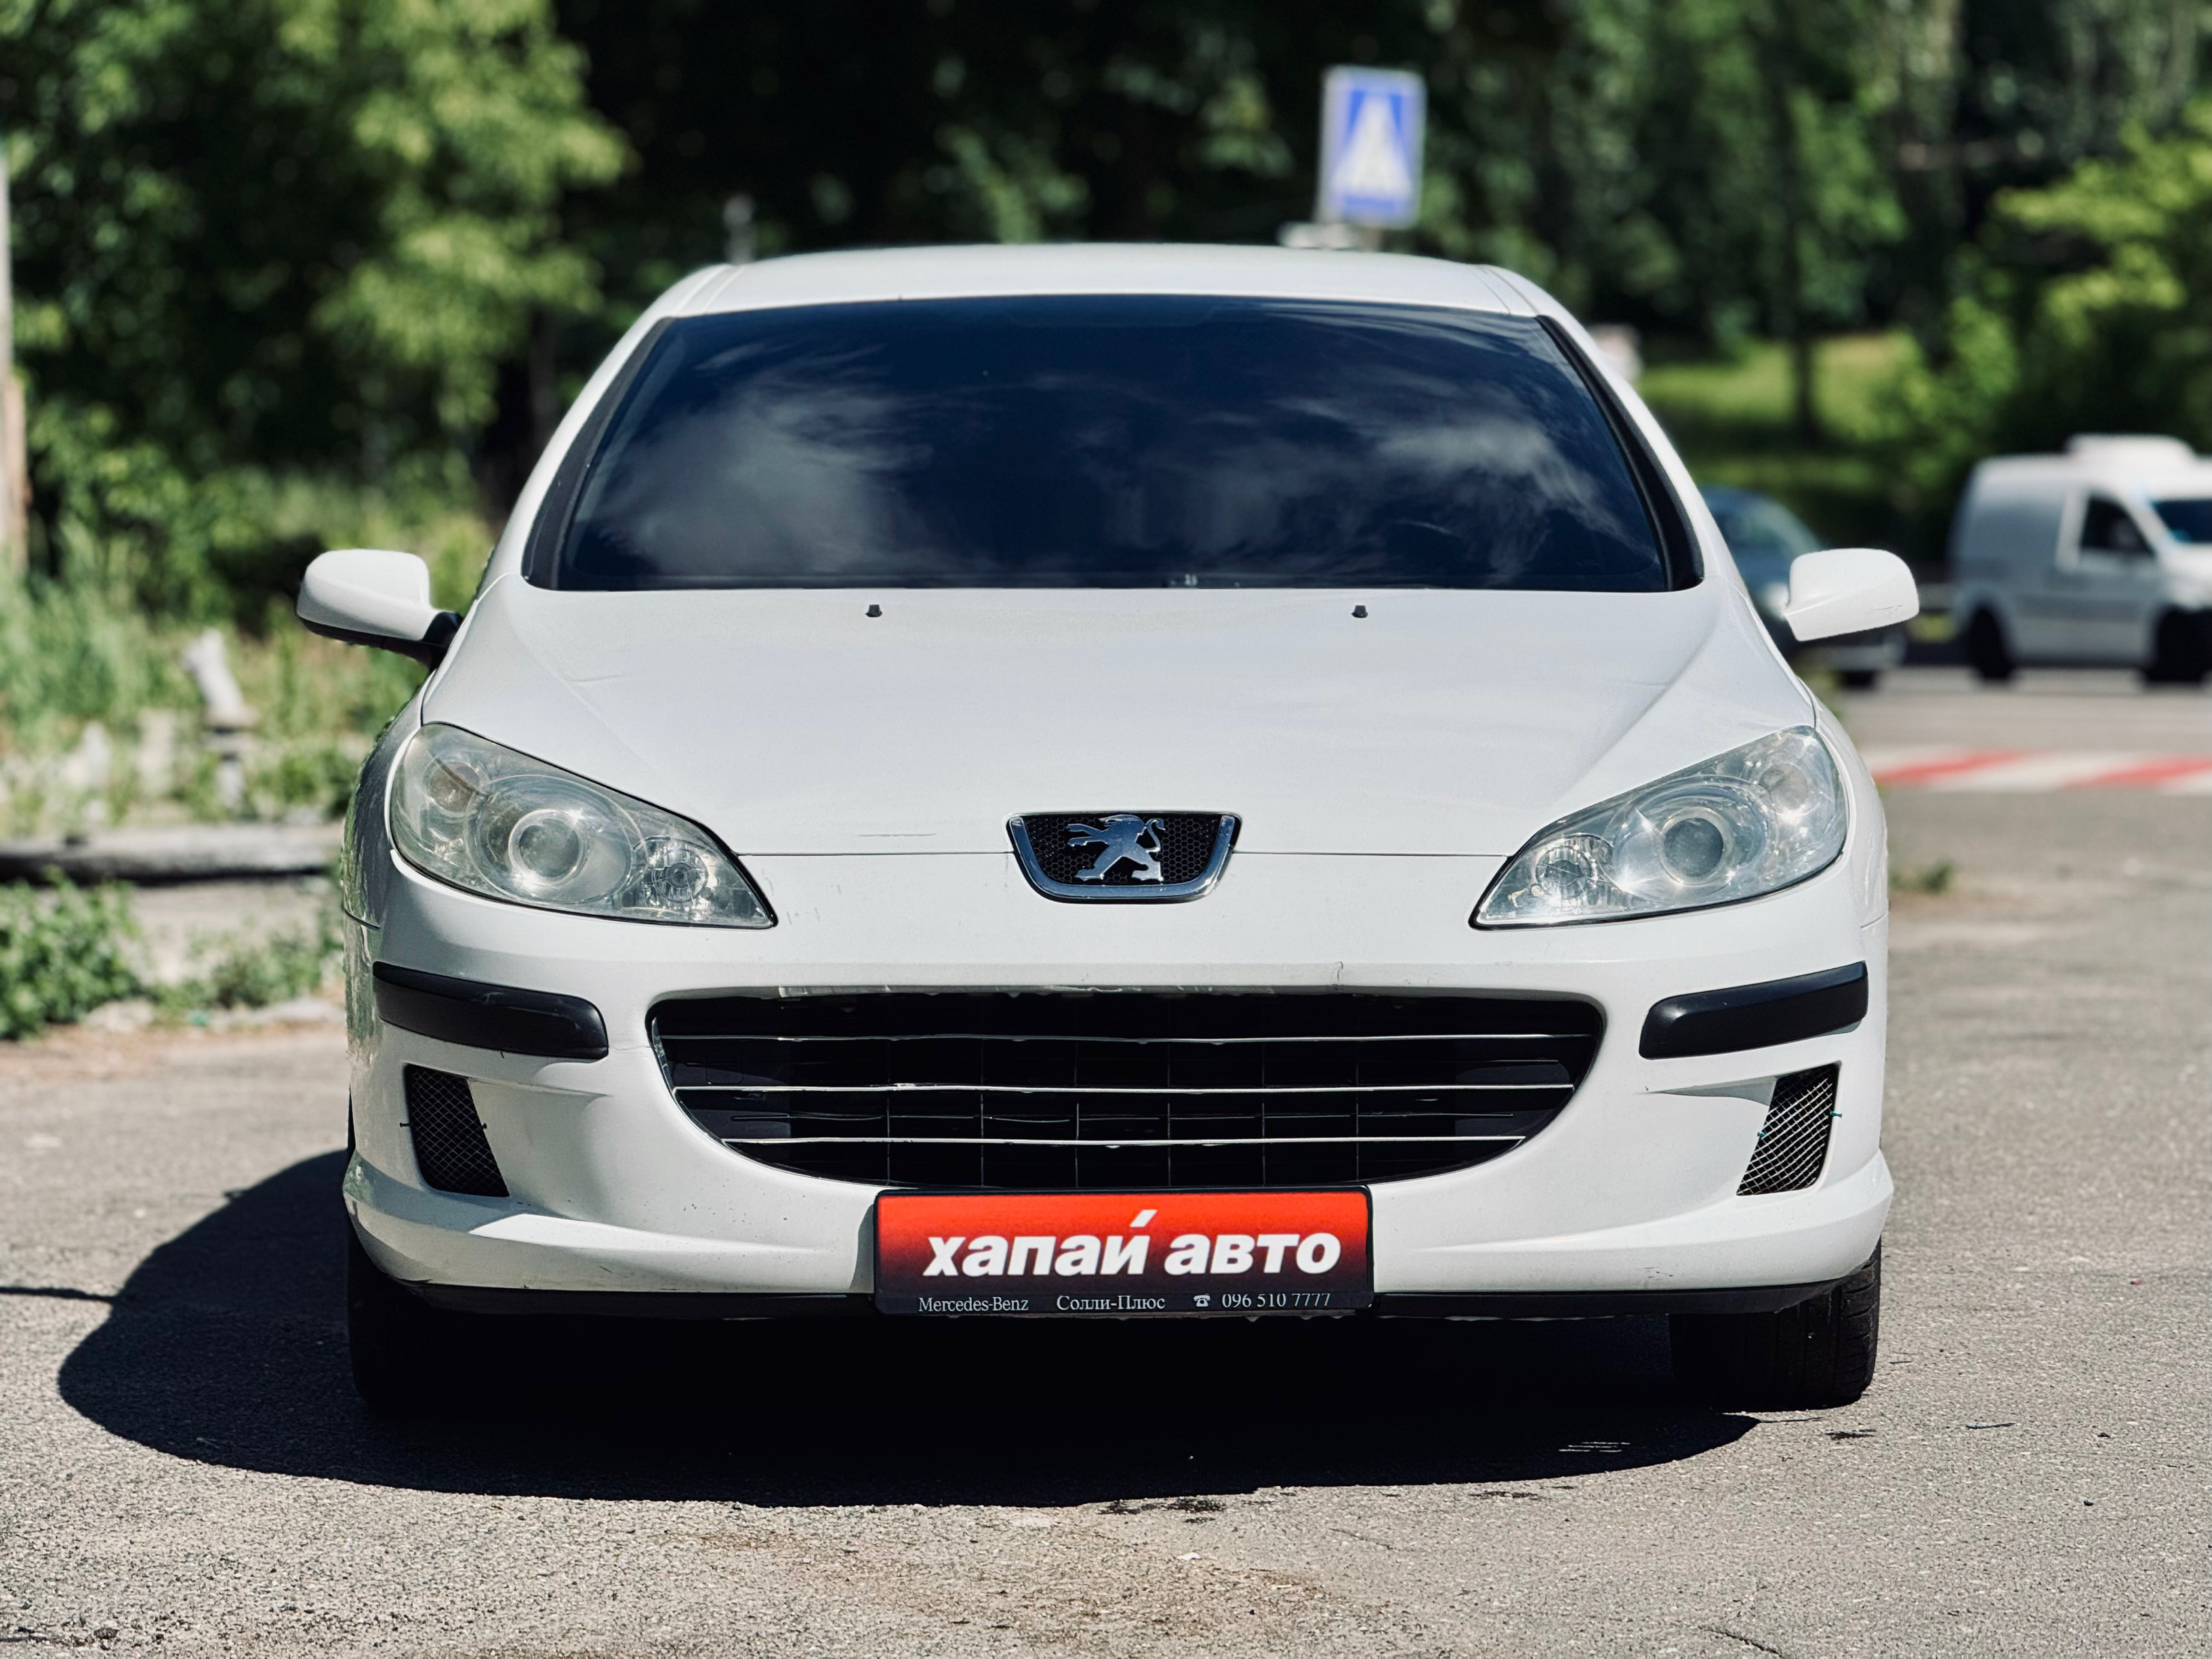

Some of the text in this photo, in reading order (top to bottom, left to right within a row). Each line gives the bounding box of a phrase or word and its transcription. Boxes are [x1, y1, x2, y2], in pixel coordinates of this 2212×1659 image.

[1164, 1232, 1342, 1276] авто
[918, 1296, 1029, 1313] Mercedes-Benz
[1056, 1294, 1166, 1311] Солли-Плюс
[1221, 1292, 1331, 1309] 096 510 7777
